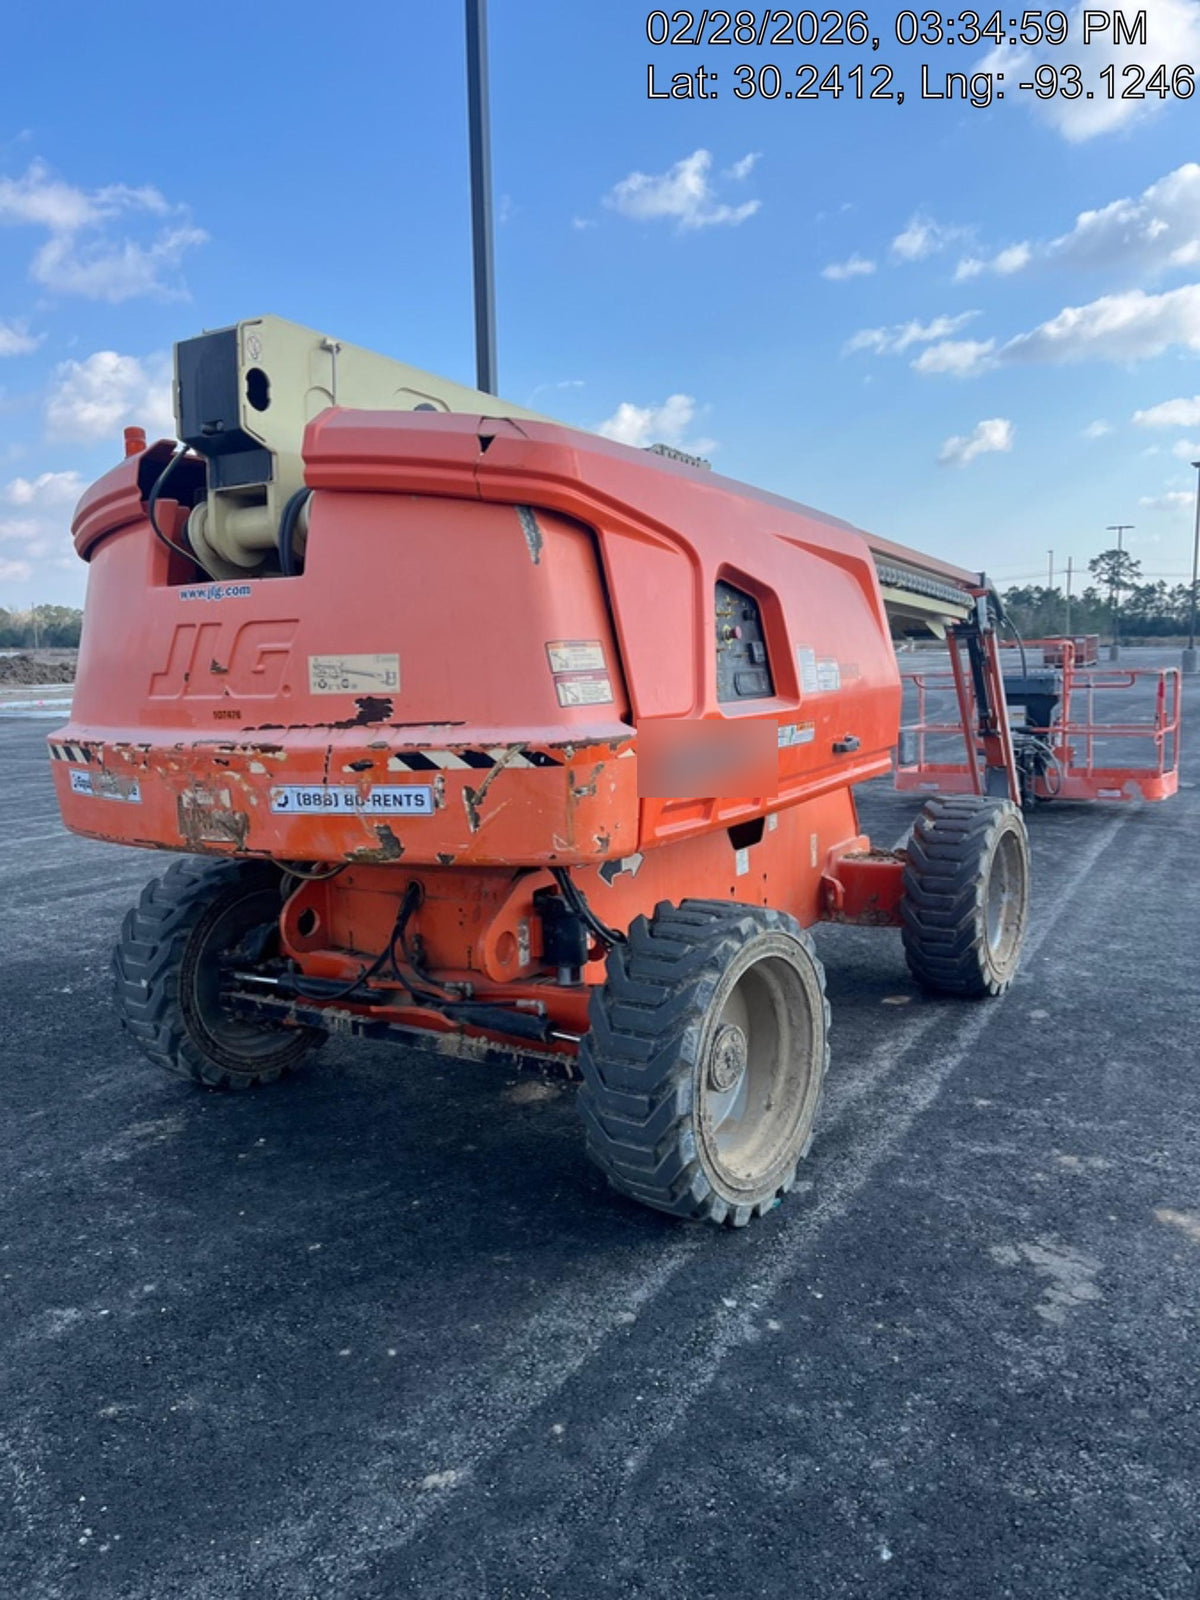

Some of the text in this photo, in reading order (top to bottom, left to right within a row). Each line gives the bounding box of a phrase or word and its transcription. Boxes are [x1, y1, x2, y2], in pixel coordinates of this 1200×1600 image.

[180, 585, 251, 601] www.jlg.com
[149, 619, 299, 699] JLG
[296, 793, 339, 808] (888)
